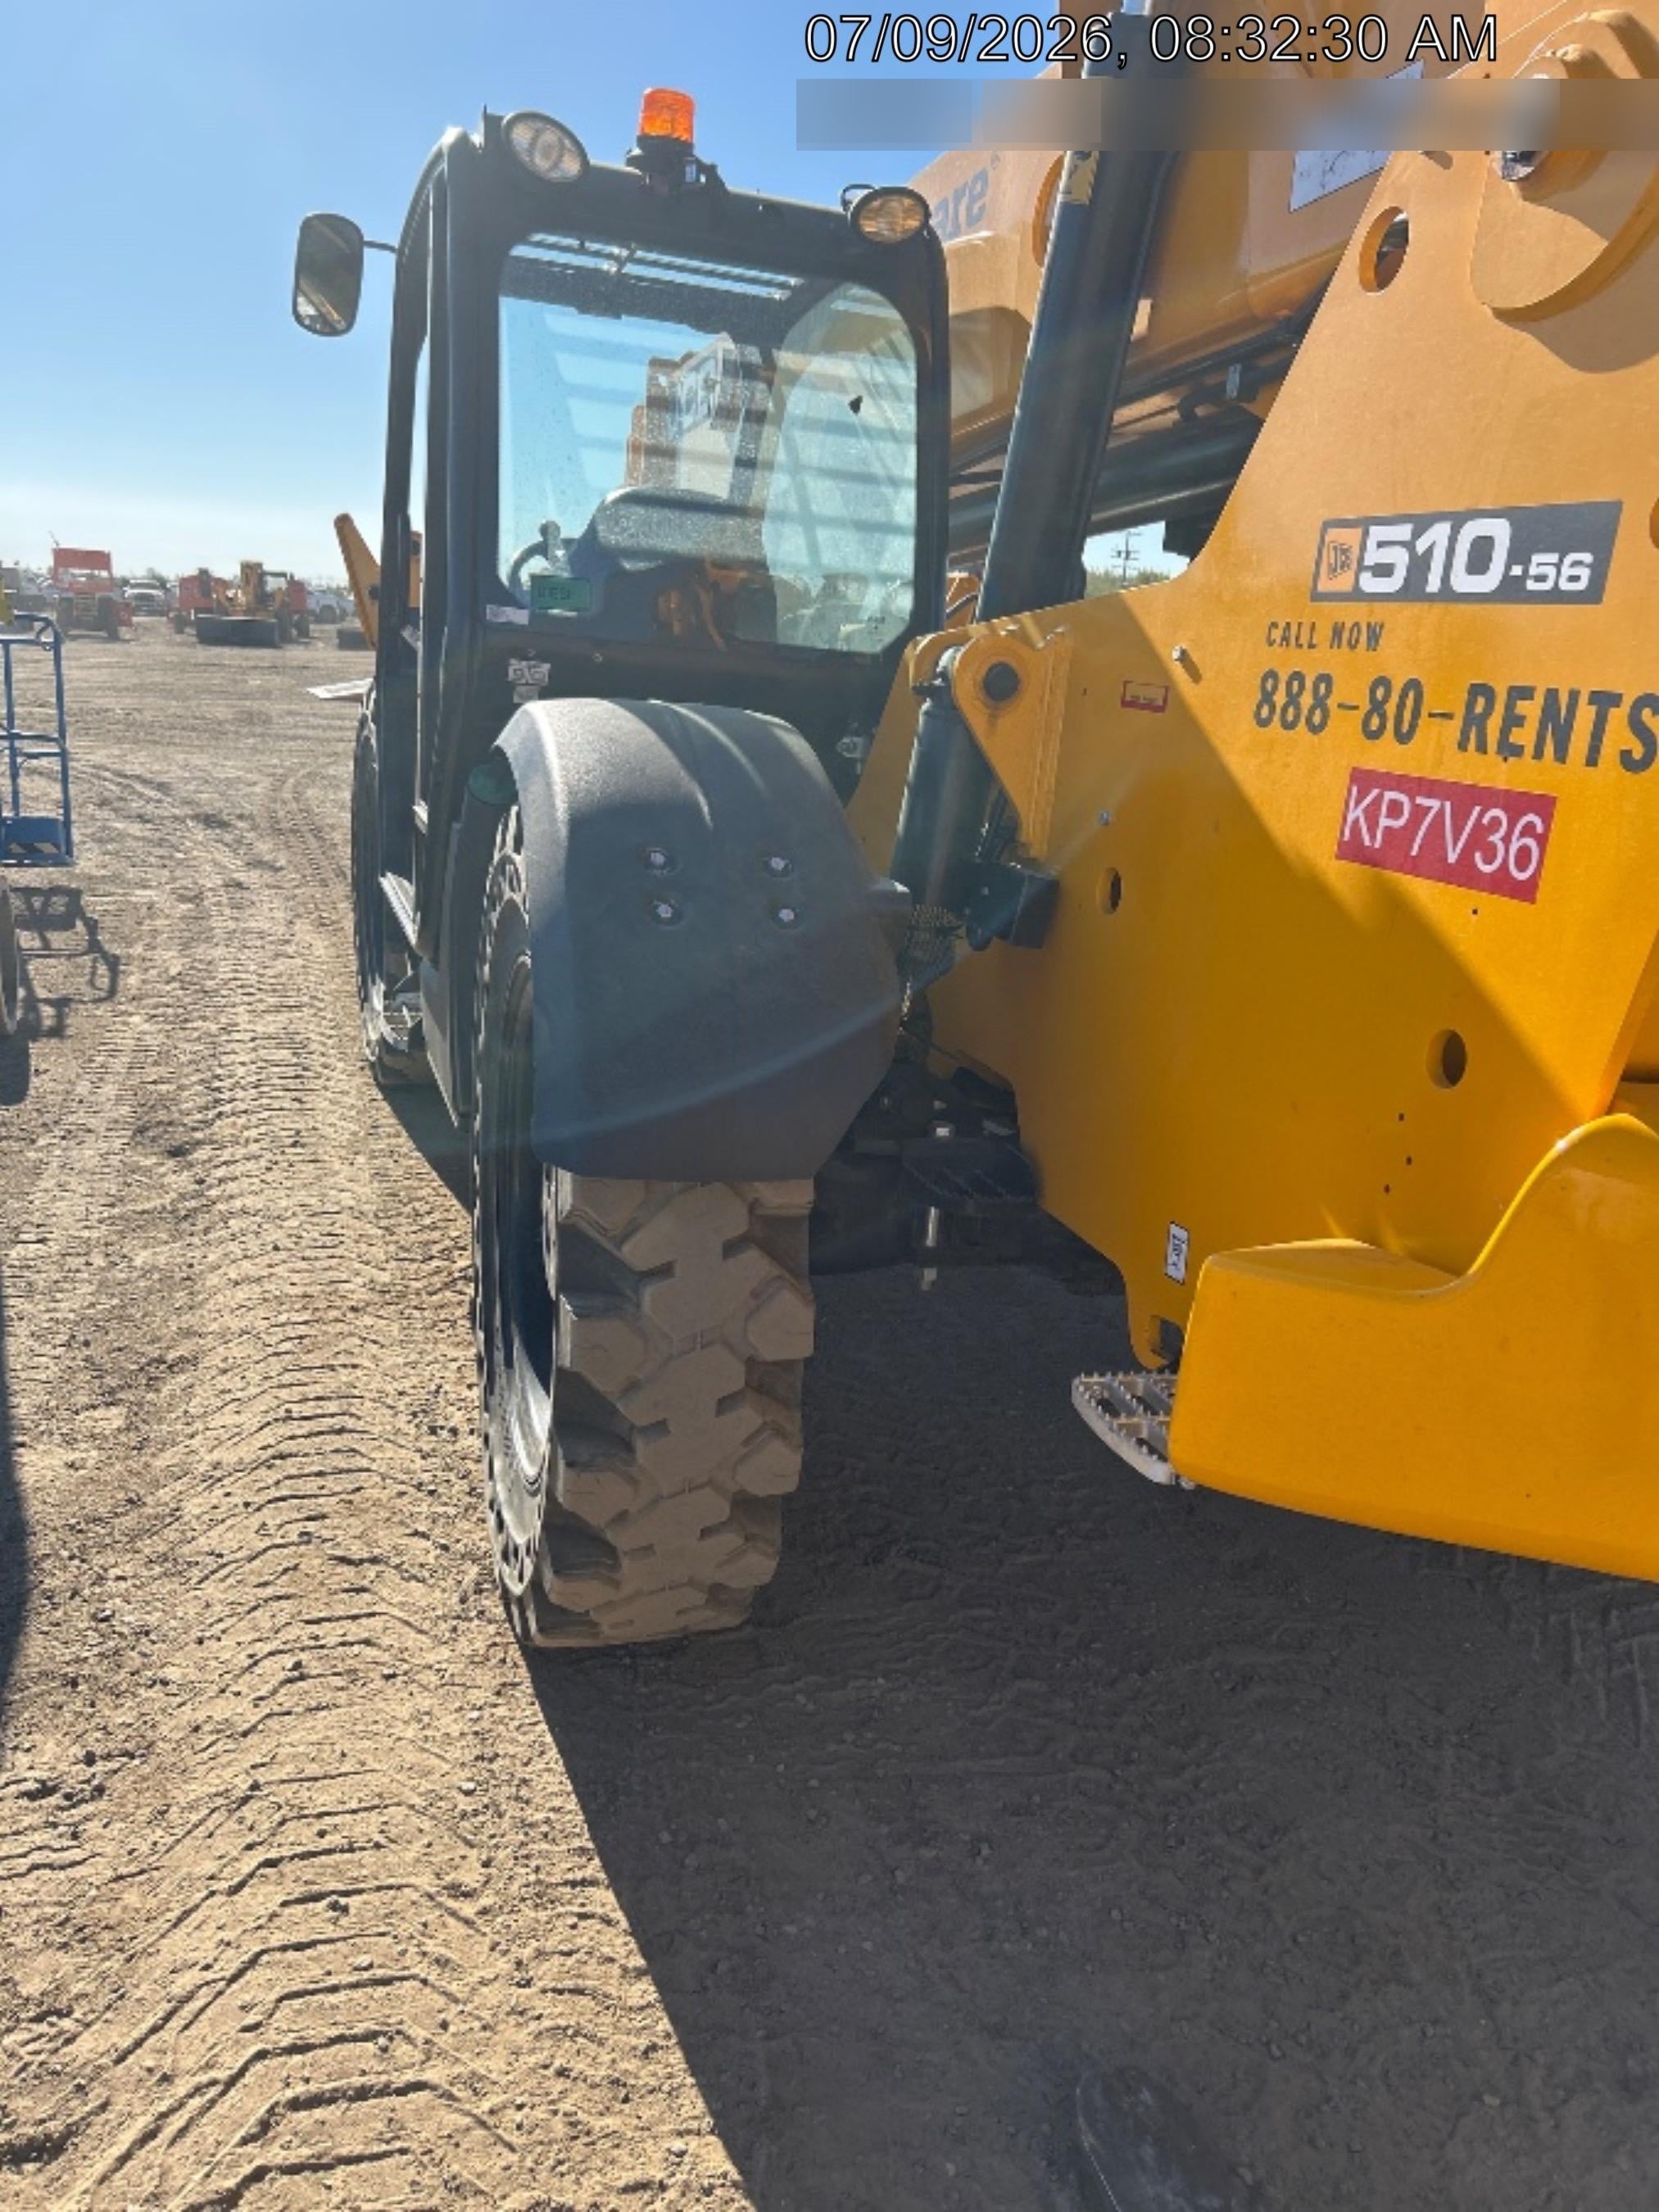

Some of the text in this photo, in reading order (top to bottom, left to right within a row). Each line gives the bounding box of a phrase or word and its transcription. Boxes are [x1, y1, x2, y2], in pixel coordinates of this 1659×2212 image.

[1266, 621, 1385, 651] CALL NOW
[1253, 669, 1659, 773] 888-80-RENTS
[1343, 786, 1544, 881] KP7V36
